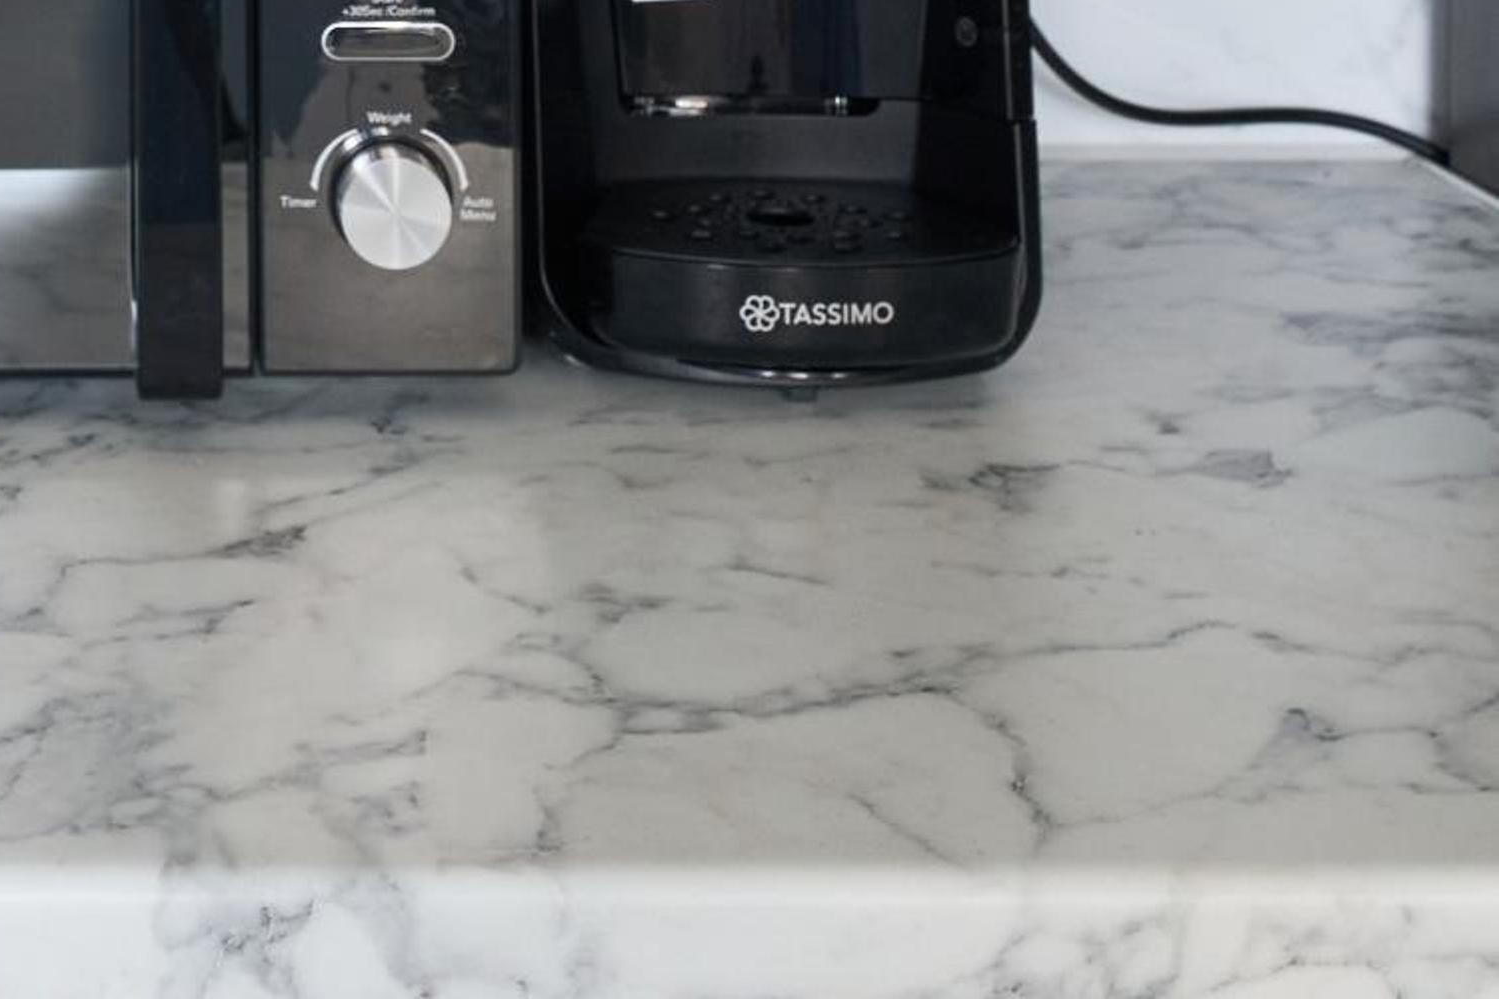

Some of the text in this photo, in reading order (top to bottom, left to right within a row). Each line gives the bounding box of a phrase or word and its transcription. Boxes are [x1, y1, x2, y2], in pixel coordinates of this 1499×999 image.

[367, 111, 412, 126] Weight
[280, 196, 317, 209] Timer
[463, 196, 494, 208] Auto
[460, 208, 496, 221] Menu
[779, 301, 894, 326] TASSIMO
